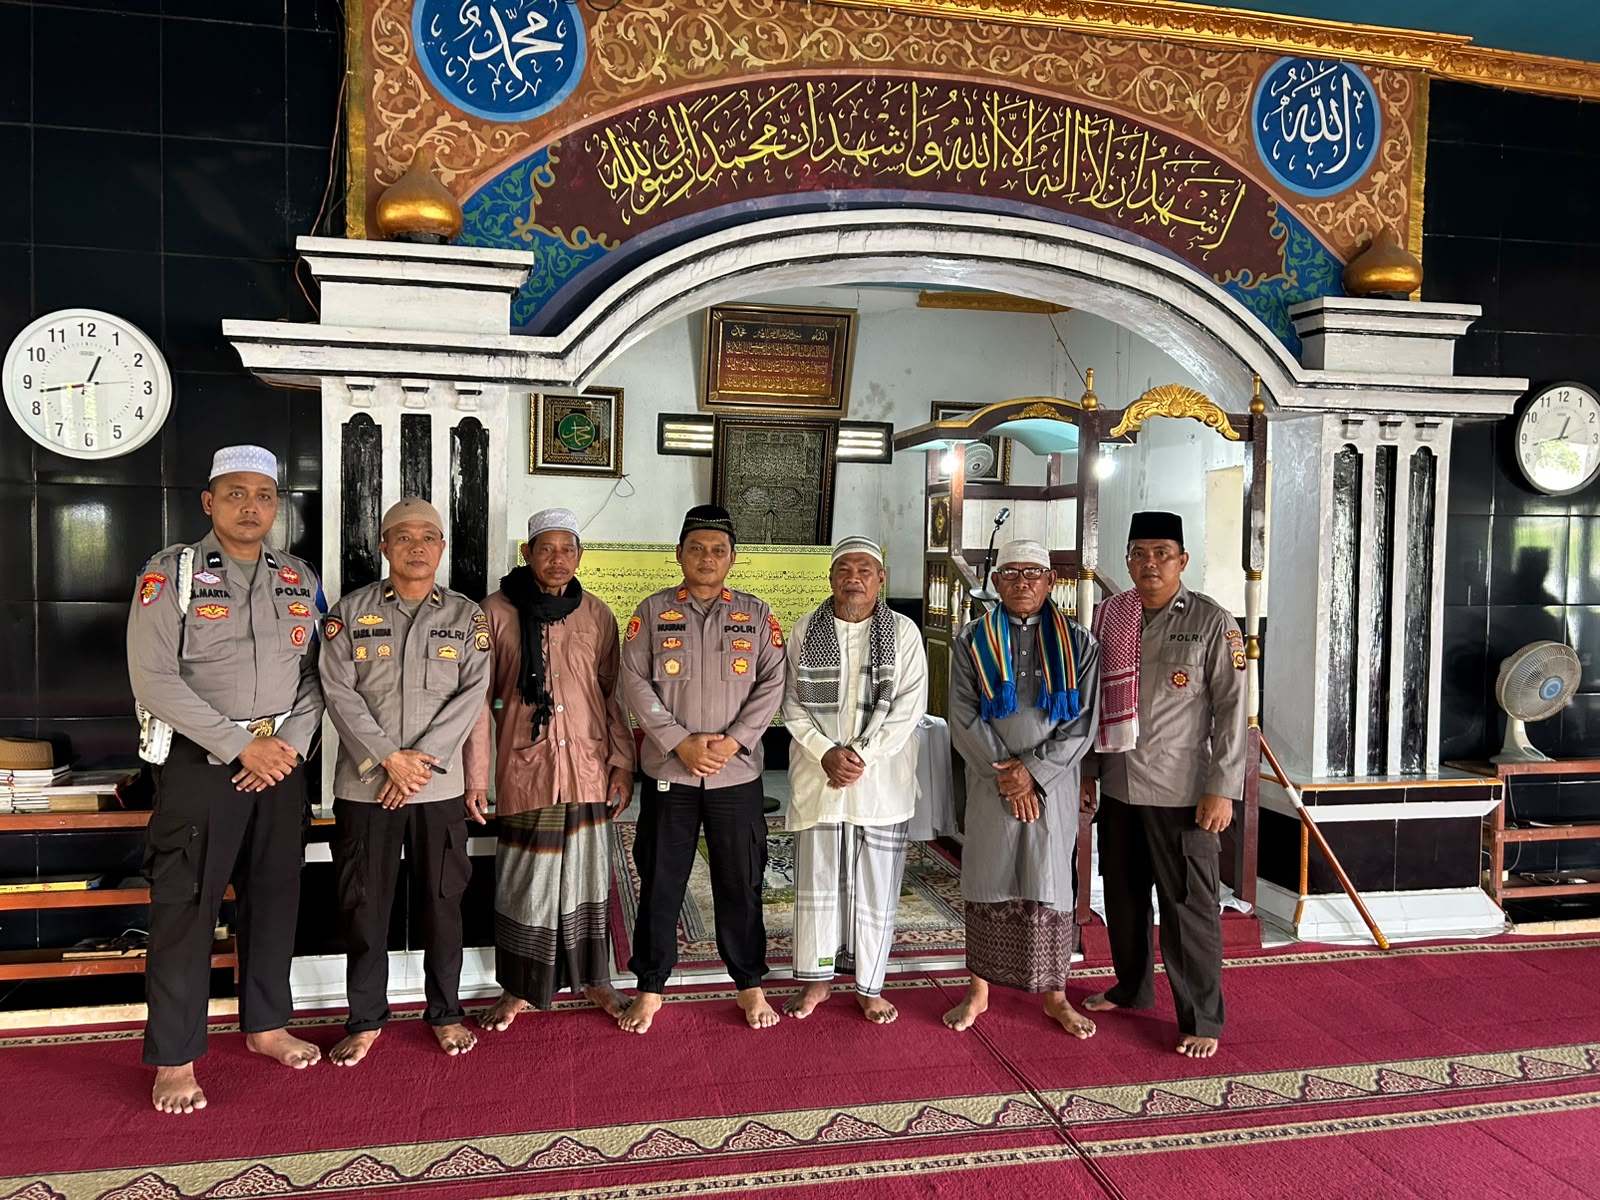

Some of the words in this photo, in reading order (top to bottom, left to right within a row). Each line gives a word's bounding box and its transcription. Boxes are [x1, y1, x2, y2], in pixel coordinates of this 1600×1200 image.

[48, 328, 65, 343] 11
[77, 323, 96, 337] 12
[112, 332, 119, 346] 1
[27, 347, 46, 362] 10
[134, 353, 143, 367] 2
[23, 375, 32, 389] 9
[143, 381, 152, 395] 3
[1540, 397, 1551, 408] 11
[1558, 391, 1570, 402] 12
[1578, 397, 1583, 408] 1
[32, 401, 41, 415] 8
[135, 406, 144, 420] 4
[1527, 412, 1537, 423] 10
[1589, 412, 1595, 424] 2
[55, 423, 64, 437] 7
[113, 425, 122, 439] 5
[84, 433, 93, 447] 6
[1522, 433, 1528, 444] 9
[1592, 433, 1599, 445] 3
[275, 587, 311, 598] POLRI
[430, 630, 465, 641] POLRI
[724, 625, 756, 634] POLRI
[1169, 634, 1203, 642] POLRI
